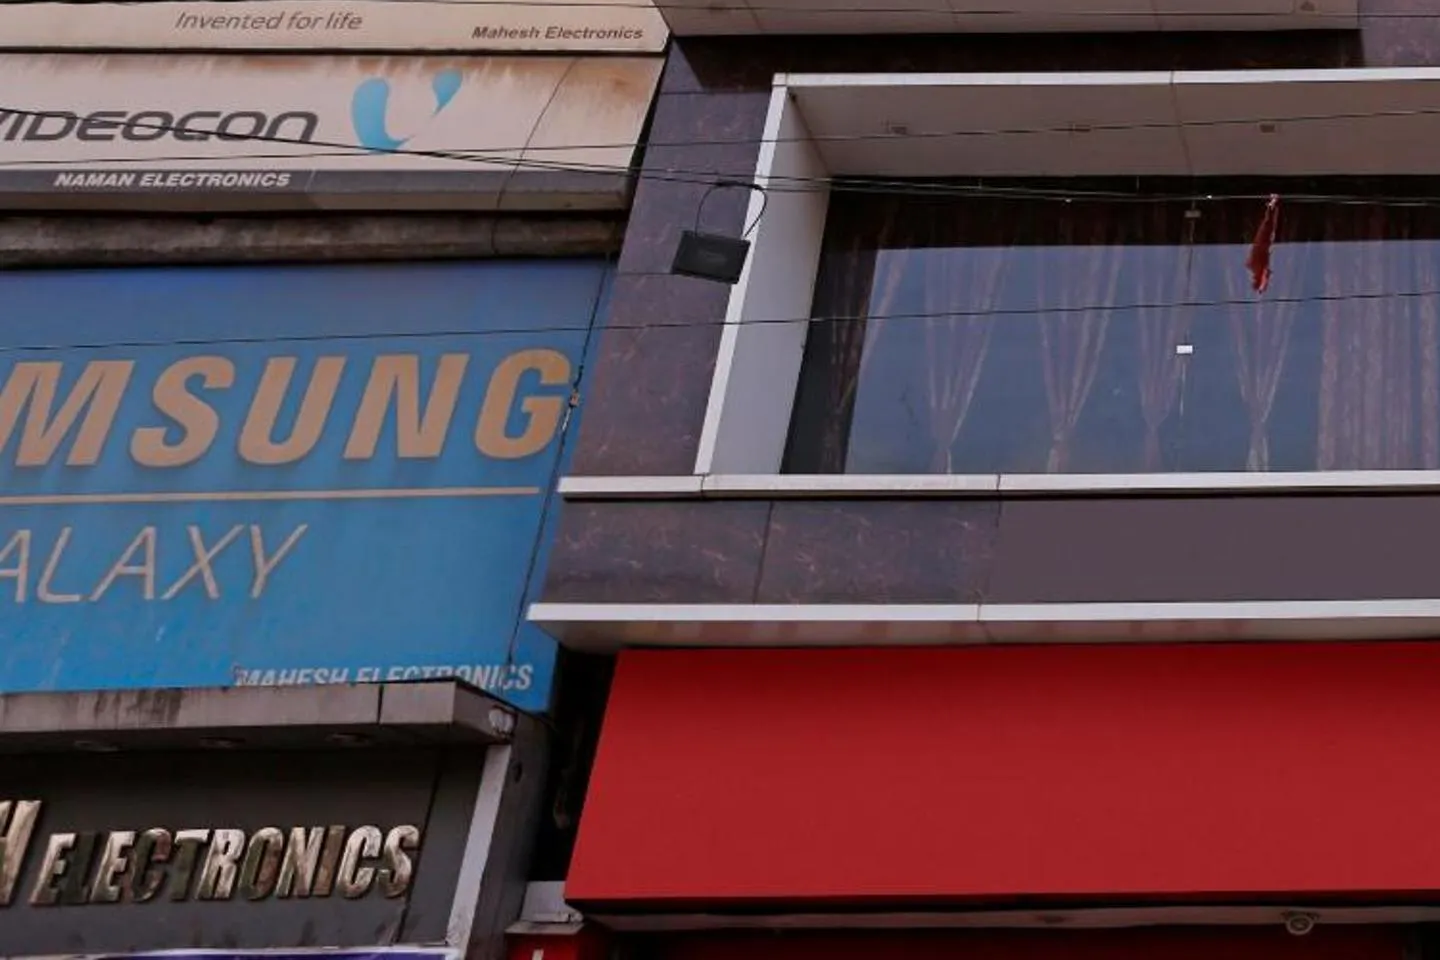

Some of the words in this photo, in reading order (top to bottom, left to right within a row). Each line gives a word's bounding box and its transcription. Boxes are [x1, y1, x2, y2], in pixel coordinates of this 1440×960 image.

[174, 11, 285, 30] Invented
[286, 11, 323, 30] for
[324, 11, 363, 30] life
[471, 25, 540, 40] Mahesh
[544, 25, 644, 40] Electronics
[54, 172, 136, 188] NAMAN
[139, 172, 291, 188] ELECTRONICS
[28, 824, 420, 906] ELECTRONICS
